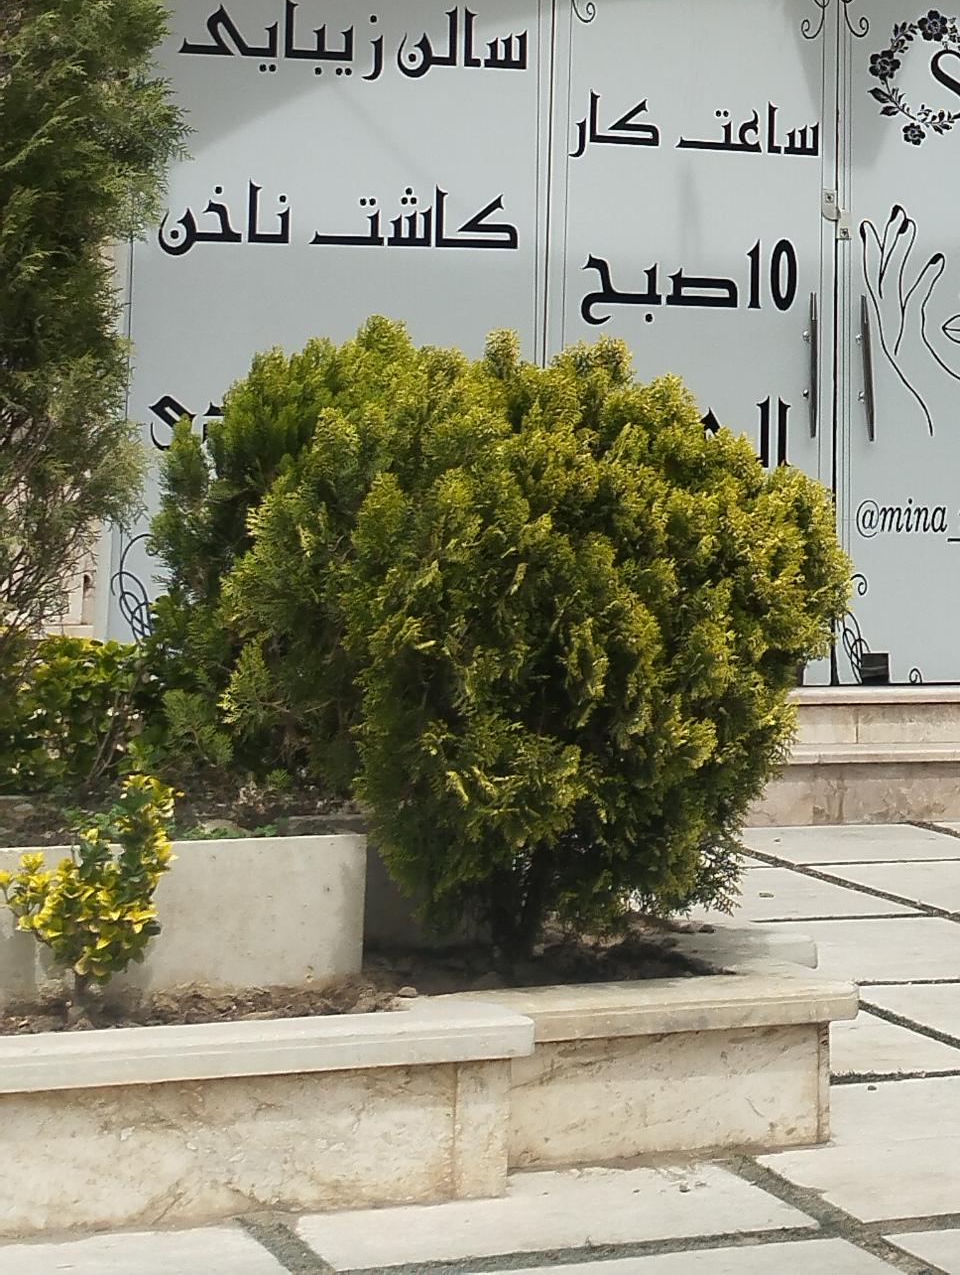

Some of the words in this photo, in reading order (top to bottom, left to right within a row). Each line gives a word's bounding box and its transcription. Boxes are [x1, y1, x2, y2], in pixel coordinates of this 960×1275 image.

[397, 5, 528, 79] سالن
[568, 89, 660, 158] کار
[675, 102, 820, 157] ساعت
[158, 180, 290, 256] ناخن
[308, 184, 518, 250] کاشت
